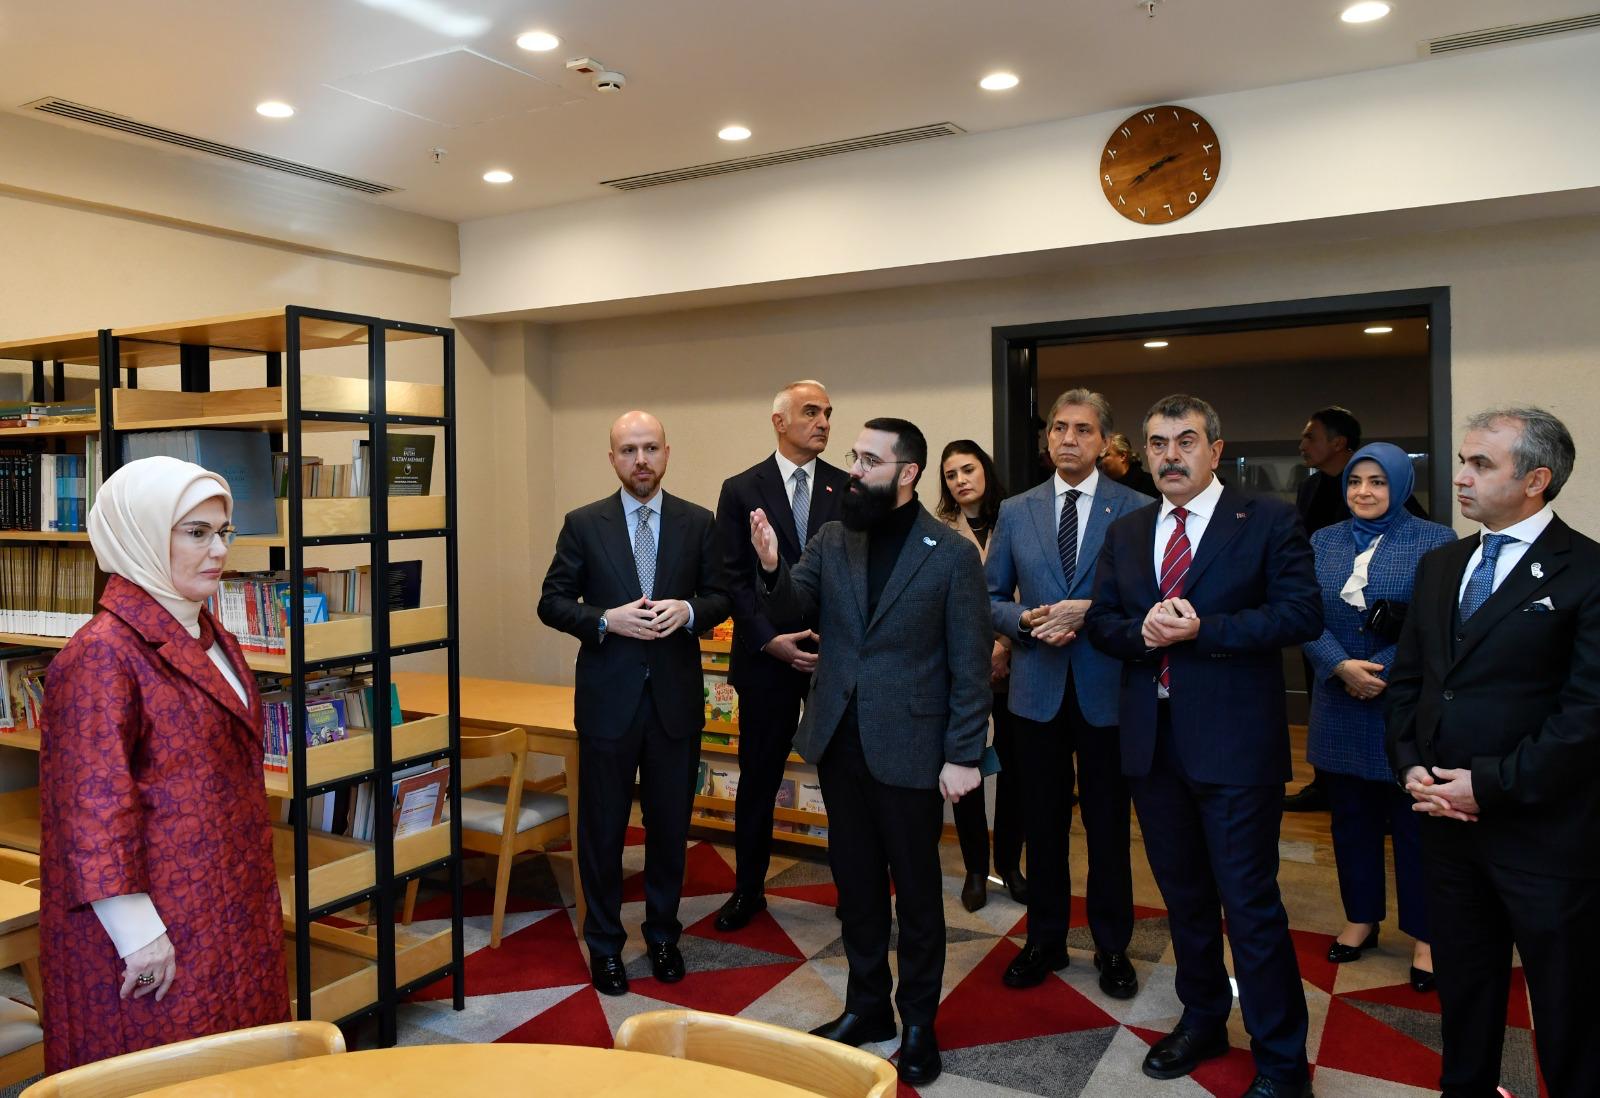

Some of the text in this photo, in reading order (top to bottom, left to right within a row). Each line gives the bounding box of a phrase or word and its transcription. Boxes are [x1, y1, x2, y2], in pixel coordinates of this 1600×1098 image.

[1202, 167, 1211, 180] ٤
[1104, 174, 1113, 186] ٩
[1117, 194, 1126, 205] ٨
[1188, 191, 1197, 204] ٥
[1137, 206, 1146, 218] ٧
[1163, 204, 1173, 216] ٦
